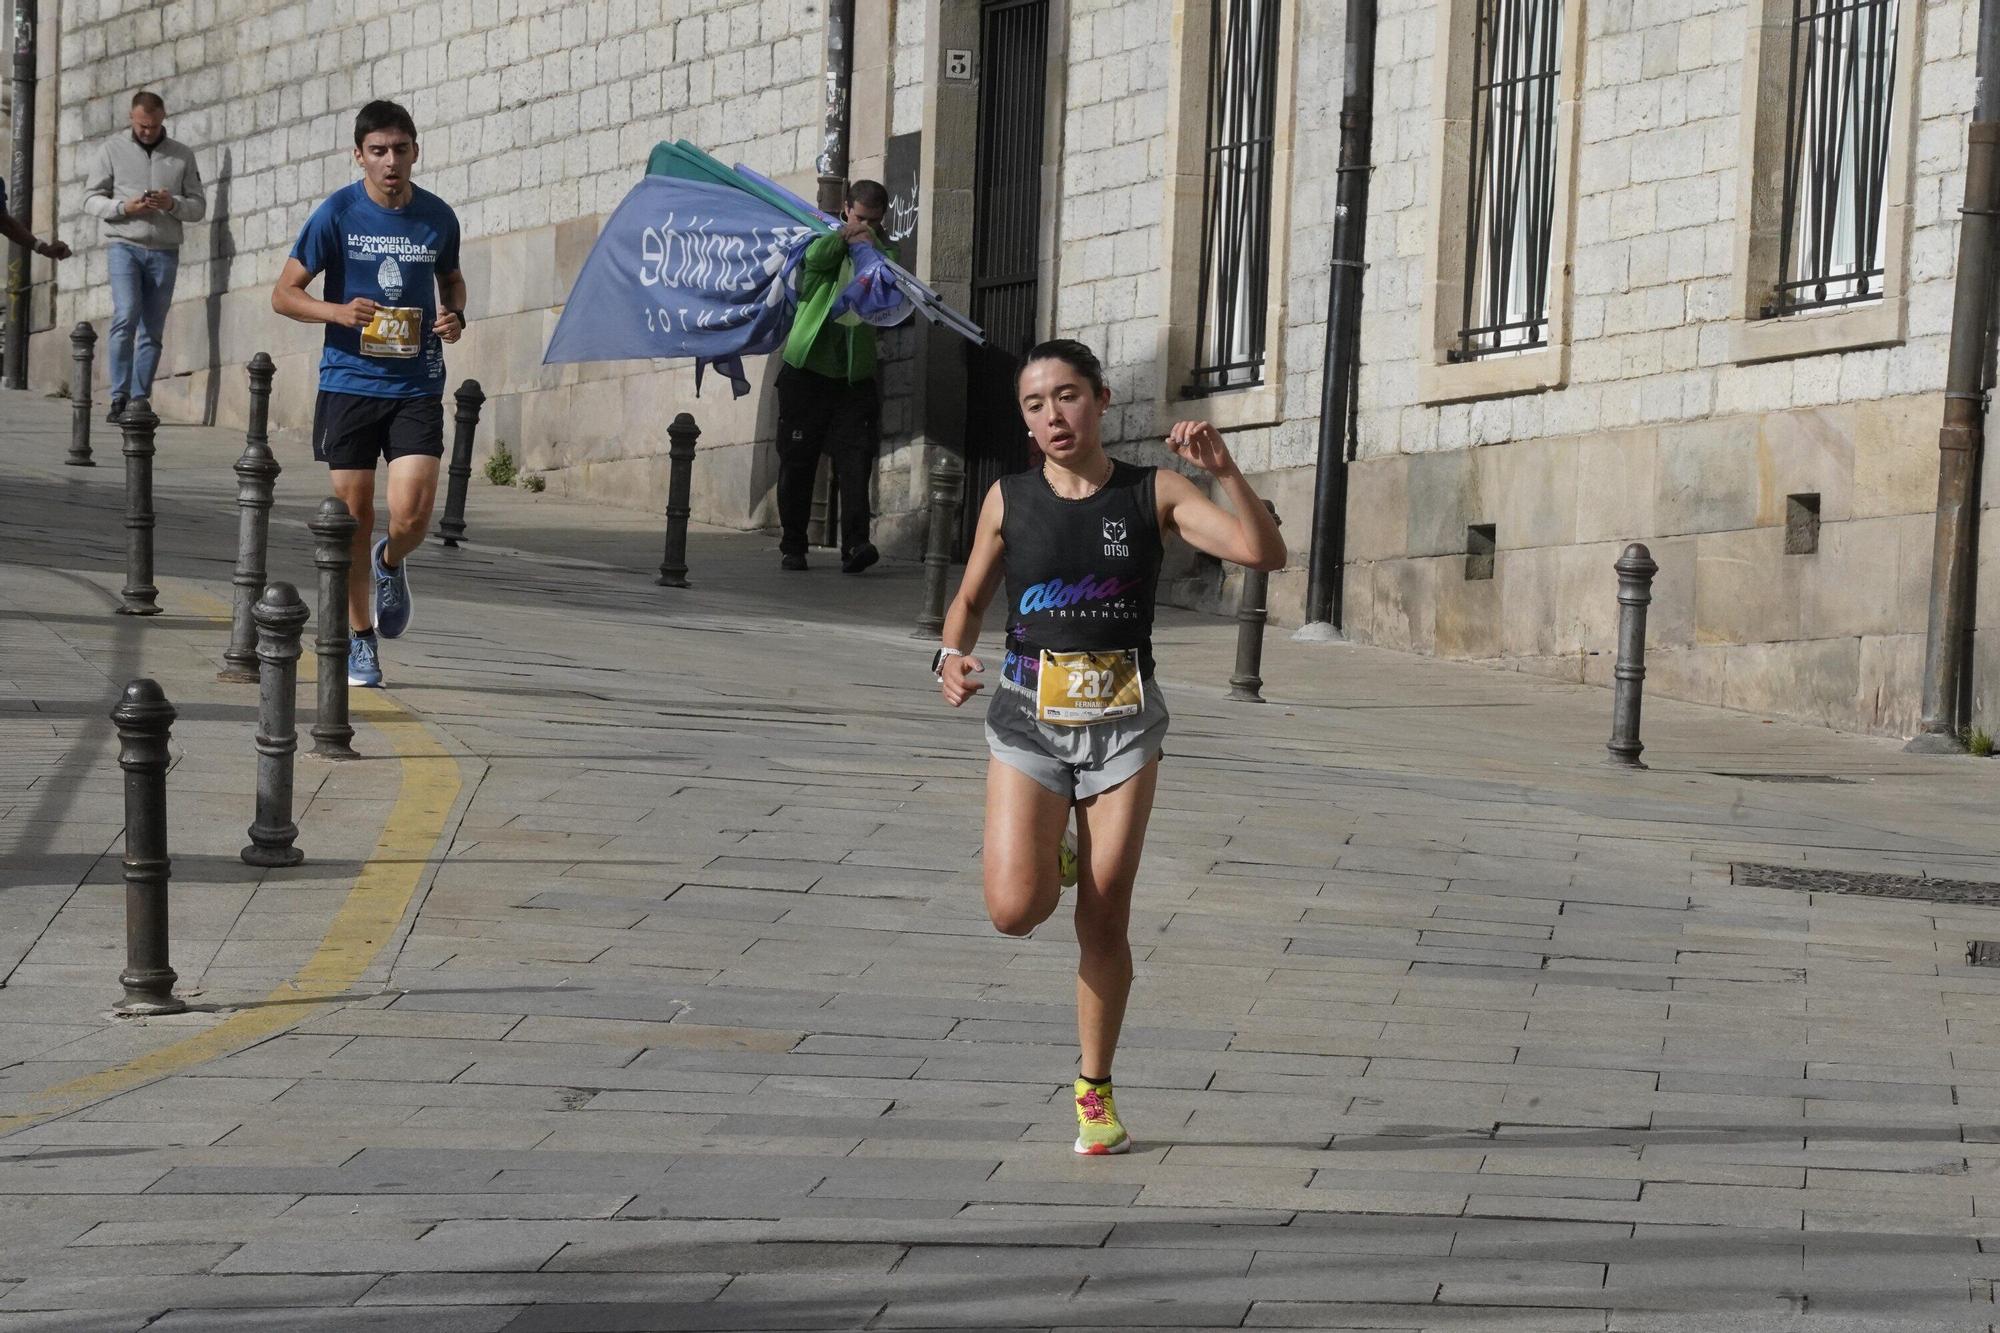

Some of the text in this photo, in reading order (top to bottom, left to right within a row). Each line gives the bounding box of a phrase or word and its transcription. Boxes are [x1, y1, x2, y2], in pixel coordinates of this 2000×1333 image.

[951, 54, 966, 74] 3
[360, 236, 411, 246] CONQUISTA
[362, 243, 428, 255] ALMENDRA
[399, 254, 436, 263] KONKISTA
[377, 320, 409, 339] 424
[1104, 544, 1129, 557] OTSO
[1049, 610, 1138, 619] TRIATHLON
[1067, 670, 1114, 698] 232
